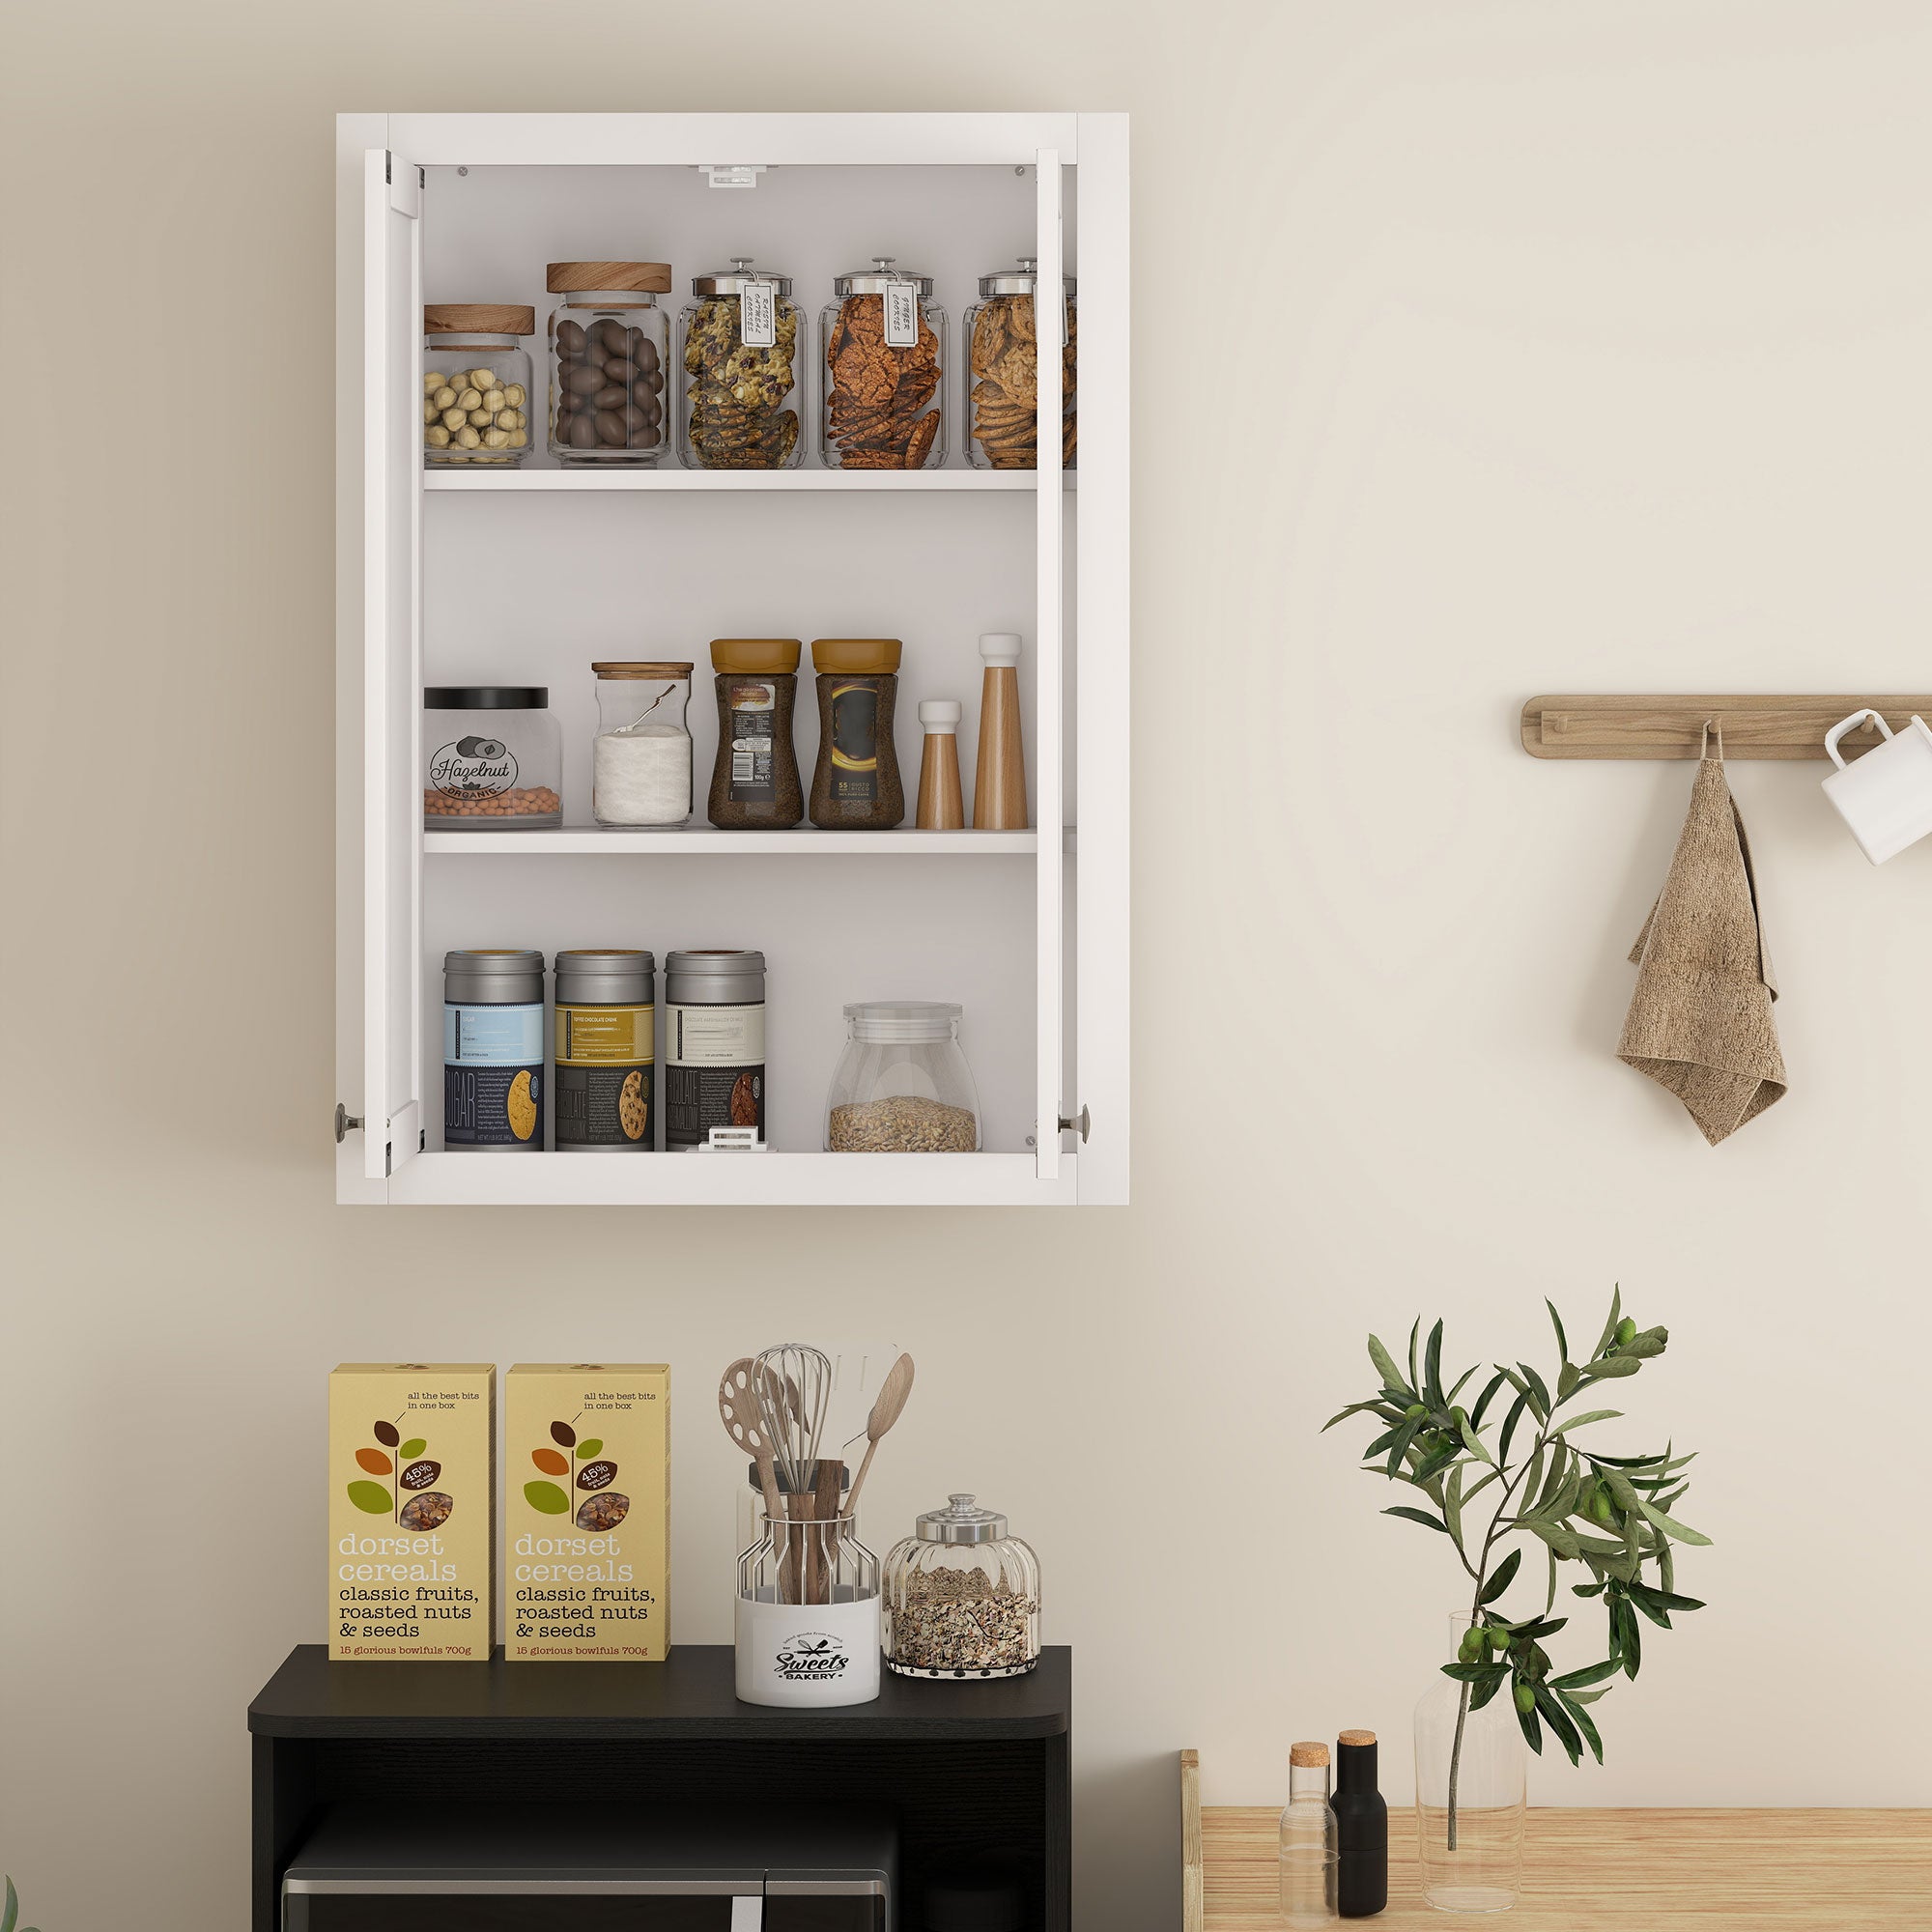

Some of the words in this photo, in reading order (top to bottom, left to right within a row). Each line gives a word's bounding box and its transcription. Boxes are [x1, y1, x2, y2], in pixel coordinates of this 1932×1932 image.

[430, 758, 510, 781] Hazelnut
[446, 787, 497, 800] ORGANIC
[406, 1463, 432, 1482] 45%
[582, 1463, 609, 1482] 45%
[338, 1533, 444, 1556] dorset
[515, 1533, 620, 1556] dorset
[338, 1559, 457, 1582] cereals
[515, 1559, 634, 1582] cereals
[339, 1586, 410, 1602] classic
[415, 1586, 479, 1604] fruits,
[516, 1586, 586, 1602] classic
[591, 1586, 656, 1604] fruits,
[339, 1605, 418, 1619] roasted
[424, 1605, 471, 1619] nuts
[516, 1605, 595, 1620] roasted
[601, 1605, 648, 1620] nuts
[339, 1622, 357, 1637] &
[362, 1623, 420, 1637] seeds
[516, 1623, 534, 1637] &
[539, 1623, 596, 1637] seeds
[340, 1646, 352, 1655] 15
[354, 1646, 396, 1656] glorious
[399, 1646, 443, 1655] bowlfuls
[445, 1646, 471, 1656] 700g
[517, 1646, 528, 1655] 15
[530, 1646, 573, 1657] glorious
[575, 1646, 620, 1655] bowlfuls
[622, 1646, 648, 1657] 700g
[774, 1652, 849, 1672] Sweets
